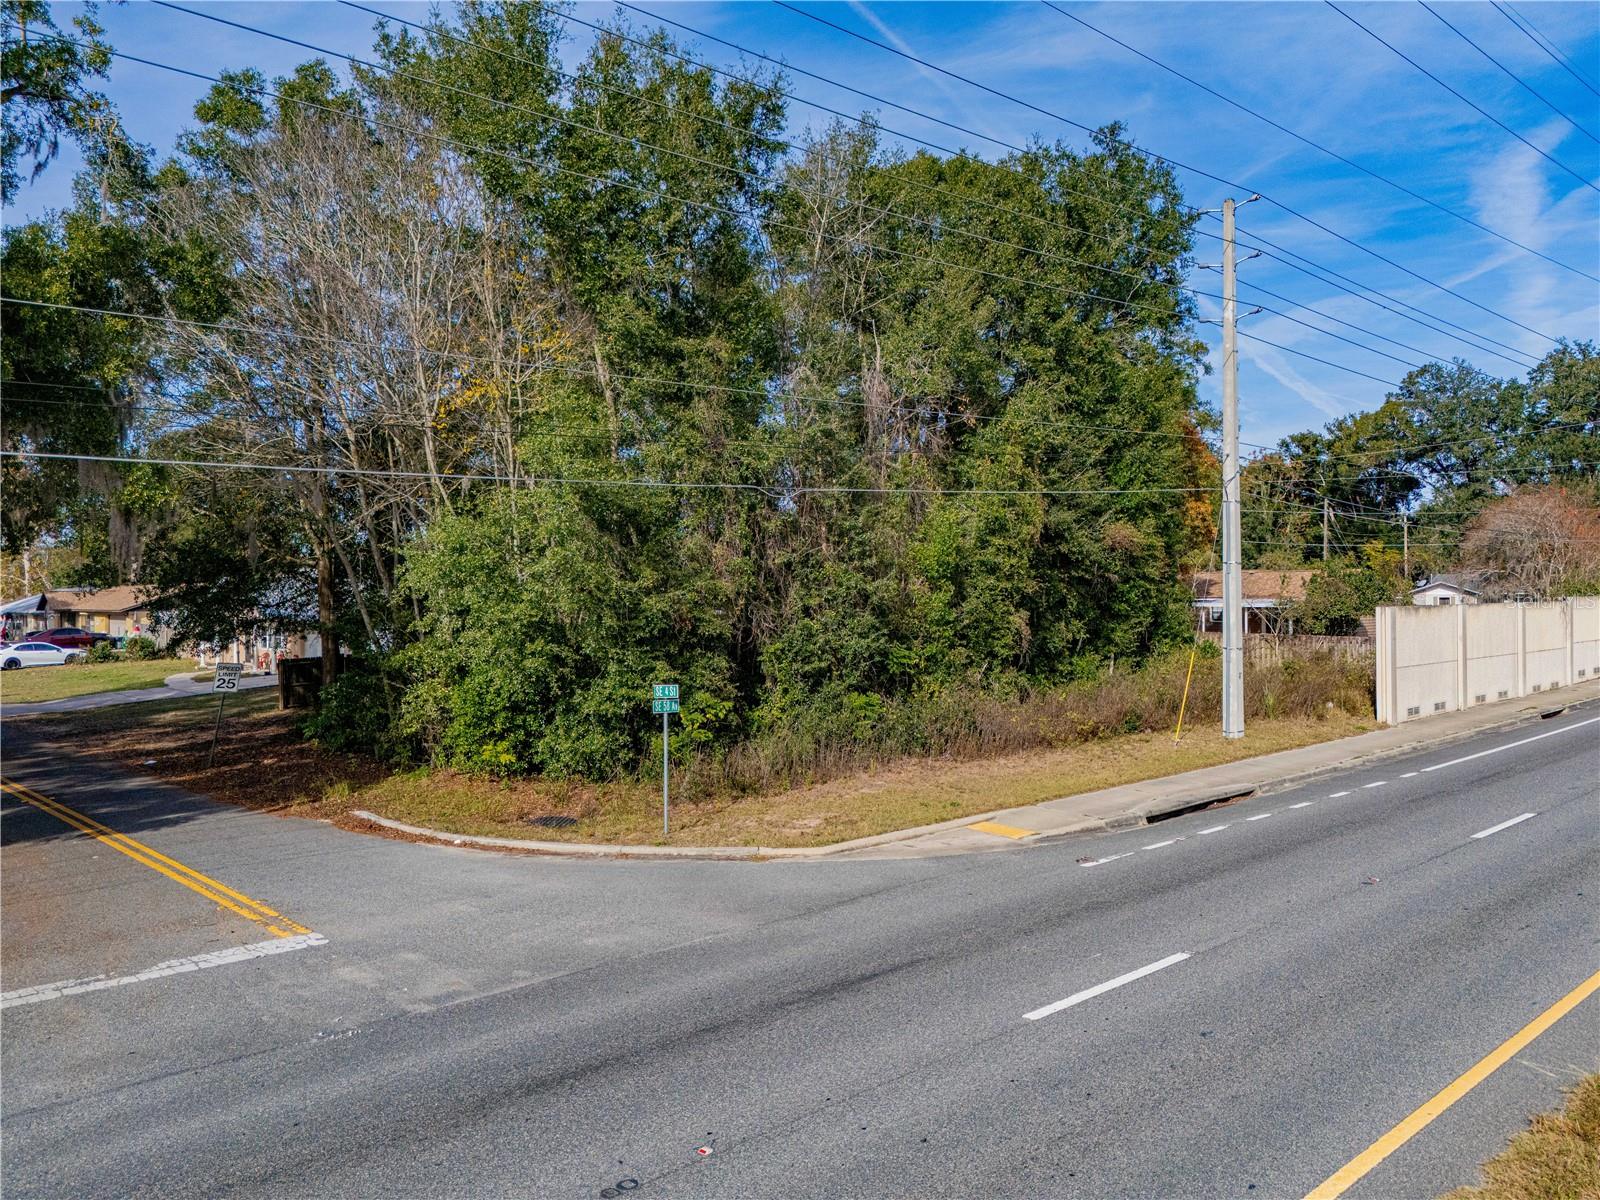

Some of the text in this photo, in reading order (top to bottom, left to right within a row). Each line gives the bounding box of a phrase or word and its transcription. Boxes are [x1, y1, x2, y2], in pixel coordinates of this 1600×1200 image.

[216, 677, 236, 689] 25
[655, 686, 663, 697] SE
[655, 701, 662, 712] SE
